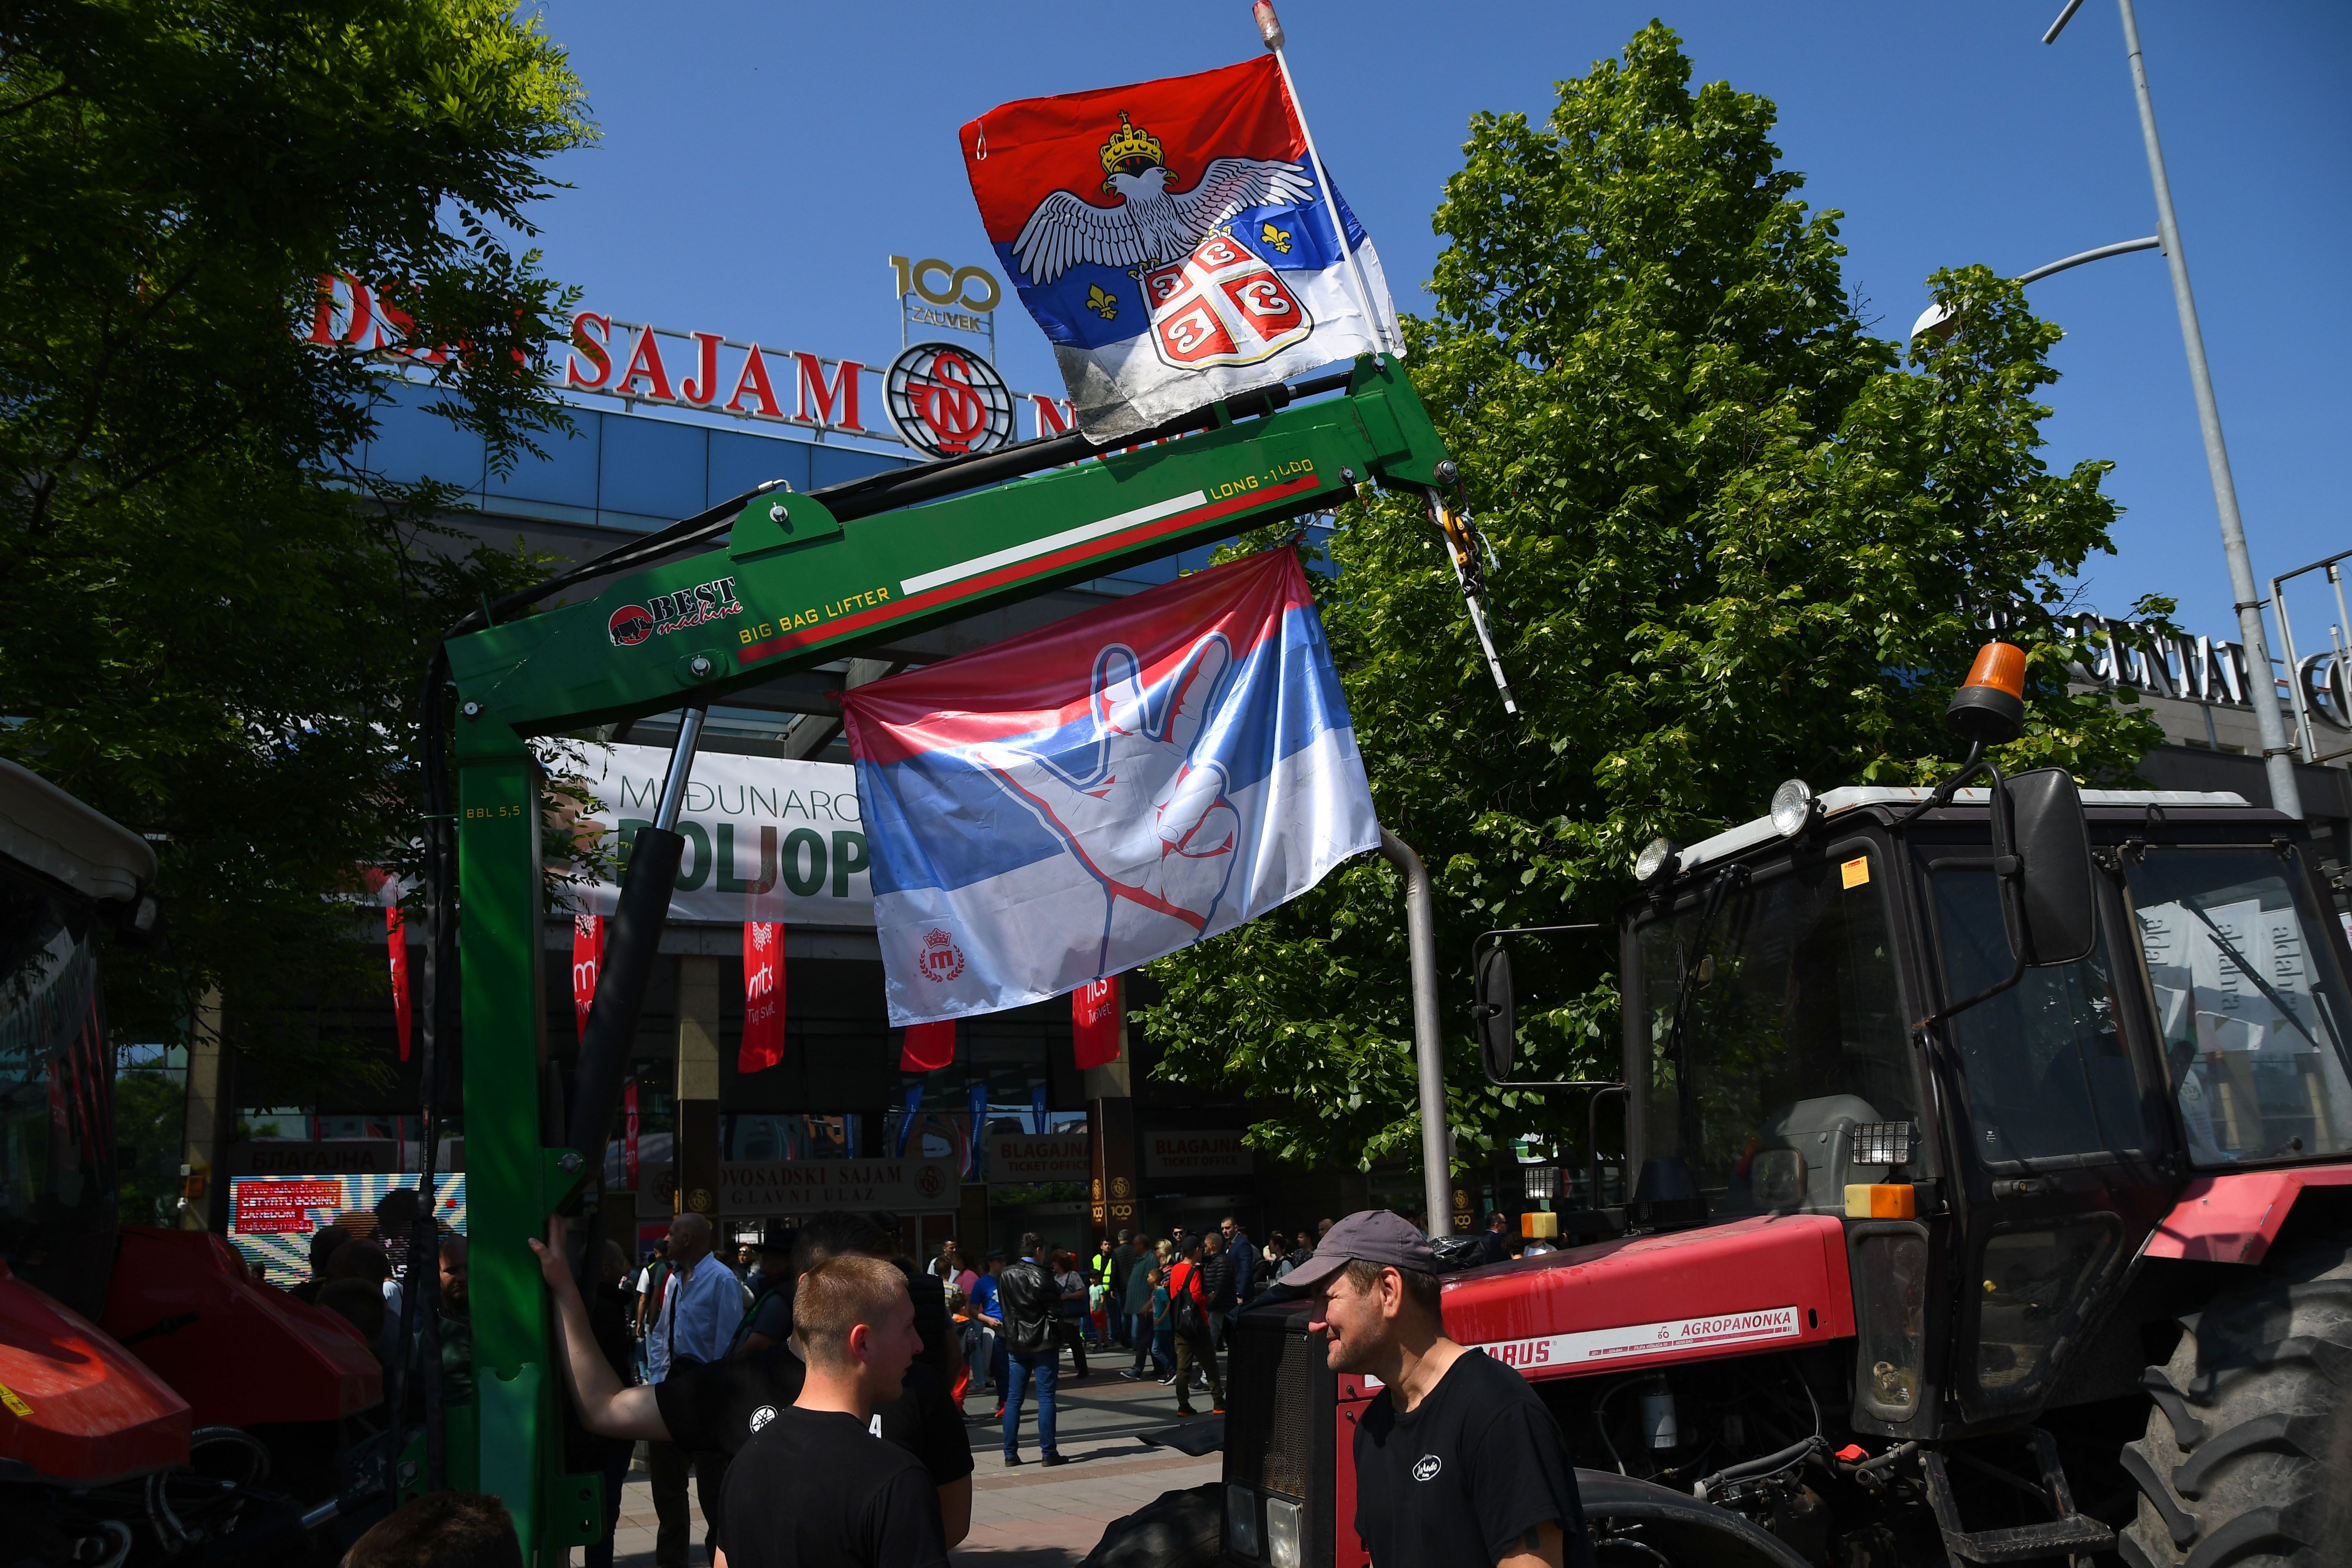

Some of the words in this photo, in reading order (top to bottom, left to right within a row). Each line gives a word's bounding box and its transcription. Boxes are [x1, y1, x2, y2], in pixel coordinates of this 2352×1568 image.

[889, 254, 1001, 314] 100
[912, 305, 981, 332] ZAUVEK
[566, 310, 867, 435] SAJAM
[1210, 476, 1259, 500] LONG
[648, 576, 736, 621] BEST
[656, 601, 743, 635] machine
[738, 623, 773, 645] BIG
[779, 609, 819, 632] BAG
[825, 587, 891, 618] LIFTER
[620, 775, 860, 822] MĐUNARO
[467, 808, 493, 818] BBL
[499, 806, 520, 818] 5,5
[748, 961, 773, 1002] mts
[1156, 1139, 1242, 1154] BLAGAJNA
[253, 1151, 375, 1170] БЛАГАЈНА
[1008, 1161, 1047, 1171] TICKET
[1051, 1160, 1090, 1171] OFFICE
[1162, 1157, 1199, 1167] TICKET
[1202, 1156, 1238, 1166] OFFICE
[839, 1166, 901, 1184] SAJAM
[732, 1189, 811, 1203] GLAVNI
[824, 1187, 875, 1201] ULAZ
[1111, 1205, 1132, 1216] 100
[1681, 1312, 1790, 1337] AGROPANONKA
